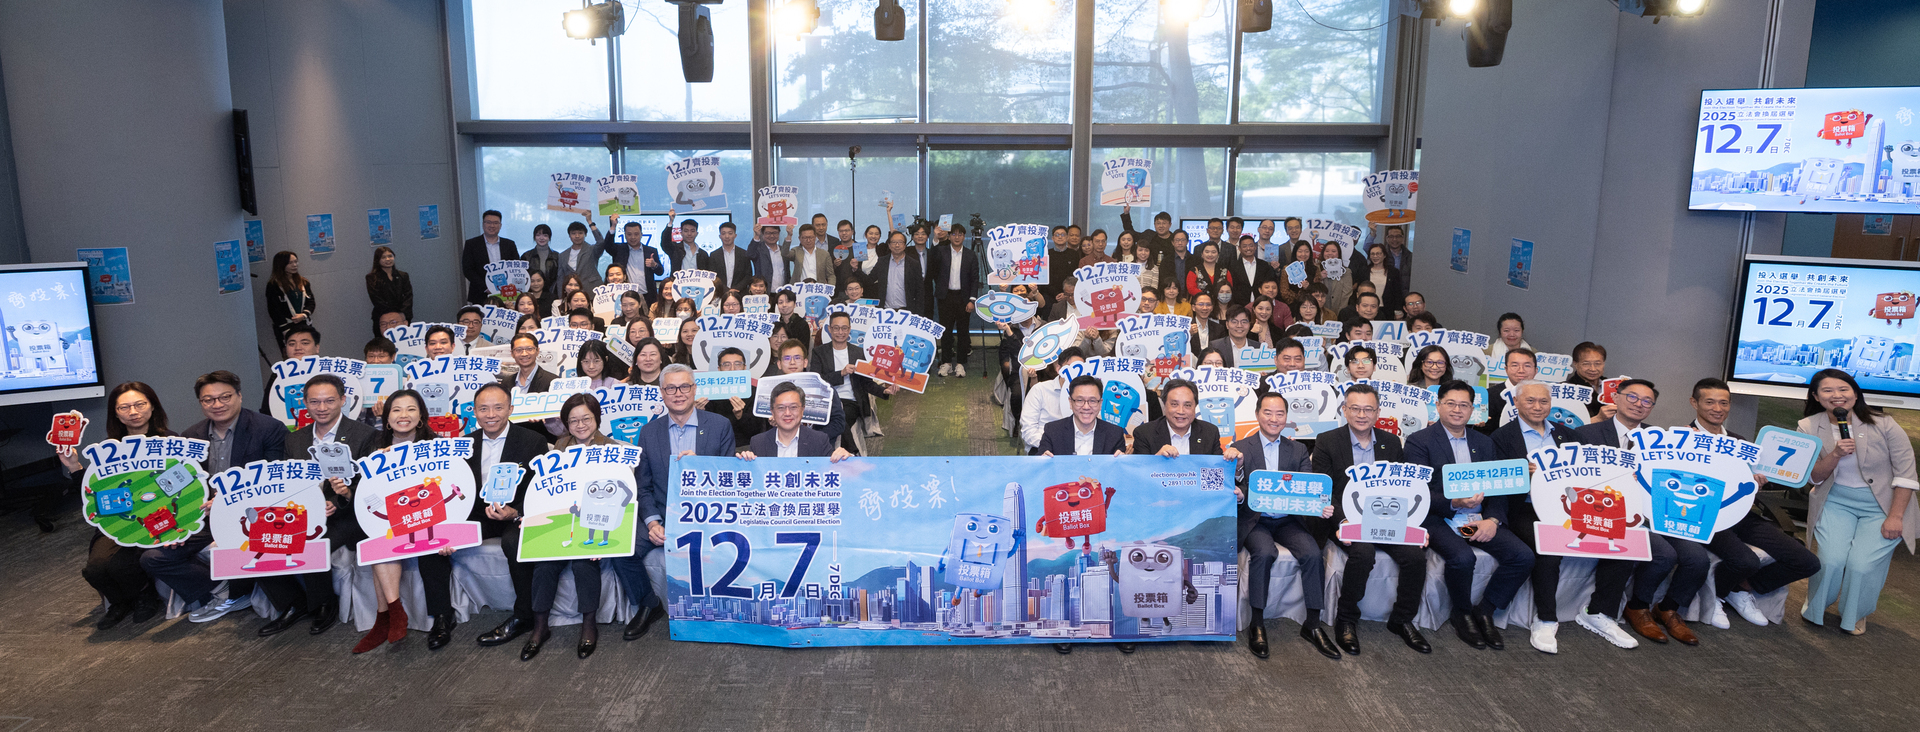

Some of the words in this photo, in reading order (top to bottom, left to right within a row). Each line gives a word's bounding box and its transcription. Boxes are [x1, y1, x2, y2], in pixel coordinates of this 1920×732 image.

[1704, 97, 1746, 105] 投入選舉
[1754, 97, 1796, 105] 共創未來
[1702, 112, 1736, 121] 2025
[1362, 172, 1388, 187] 12.7
[1390, 170, 1418, 180] 齊投票
[989, 225, 1016, 242] 12.7
[1017, 226, 1048, 236] 齊投票
[1075, 264, 1105, 282] 12.7
[1107, 264, 1140, 275] 齊投票
[1758, 272, 1798, 280] 投入選舉
[1807, 273, 1848, 282] 共創未來
[1756, 285, 1788, 294] 2025
[498, 320, 515, 330] VOTE
[697, 315, 733, 332] 12.7
[734, 317, 773, 336] 齊投票
[875, 310, 909, 325] 12.7
[910, 315, 944, 337] 齊投票
[1118, 315, 1152, 334] 12.7
[1153, 316, 1190, 329] 齊投票
[1377, 322, 1404, 340] AI
[386, 324, 423, 343] 12.7
[734, 331, 754, 340] VOTE
[1447, 332, 1489, 347] 齊投票
[274, 357, 316, 379] 12.7
[319, 358, 364, 376] 齊投票
[407, 357, 450, 380] 12.7
[453, 357, 500, 373] 齊投票
[1102, 358, 1145, 373] 齊投票
[370, 378, 385, 393] 7
[453, 374, 478, 382] LET'S
[1214, 369, 1259, 387] 齊投票
[1266, 373, 1299, 389] 12.7
[1300, 373, 1336, 384] 齊投票
[1205, 384, 1229, 392] VOTE
[618, 403, 643, 411] VOTE
[1400, 397, 1418, 406] VOTE
[86, 438, 142, 467] 12.7
[145, 439, 206, 460] 齊投票
[1632, 430, 1690, 450] 12.7
[1694, 434, 1760, 463] 齊投票
[360, 445, 409, 479] 12.7
[413, 440, 471, 460] 齊投票
[533, 447, 583, 477] 12.7
[585, 447, 639, 465] 齊投票
[1532, 446, 1578, 472] 12.7
[1582, 447, 1636, 469] 齊投票
[1642, 451, 1674, 461] LET'S
[1679, 451, 1711, 464] VOTE
[1775, 446, 1797, 467] 7
[98, 462, 130, 477] LET'S
[132, 459, 164, 470] VOTE
[386, 466, 417, 482] LET'S
[419, 461, 450, 473] VOTE
[1348, 463, 1387, 482] 12.7
[1389, 465, 1432, 481] 齊投票
[1448, 466, 1524, 481] 2025年12月7日
[1544, 470, 1571, 482] LET'S
[1572, 467, 1601, 477] VOTE
[213, 464, 263, 495] 12.7
[267, 462, 322, 480] 齊投票
[535, 474, 564, 491] LET'S
[682, 471, 752, 488] 投入選舉
[766, 472, 840, 488] 共創未來
[1257, 478, 1324, 495] 投入選舉
[1365, 479, 1387, 488] LET'S
[1390, 479, 1412, 487] VOTE
[224, 489, 254, 506] LET'S
[255, 483, 285, 496] VOTE
[547, 482, 577, 496] VOTE
[681, 489, 694, 497] Join
[709, 489, 735, 497] Election
[737, 490, 766, 498] Together
[680, 502, 738, 524] 2025
[740, 502, 840, 516] 立法會換屆選舉
[1257, 496, 1322, 513] 共創未來
[402, 508, 433, 525] 投票箱
[740, 518, 769, 526] Legislative
[1059, 509, 1092, 525] 投票箱
[1582, 514, 1613, 528] 投票箱
[1370, 528, 1396, 537] 投票箱
[1664, 519, 1701, 535] 投票箱
[261, 533, 293, 544] 投票箱
[958, 565, 992, 579] 投票箱
[829, 575, 841, 599] DEC
[1133, 592, 1168, 603] 投票箱
